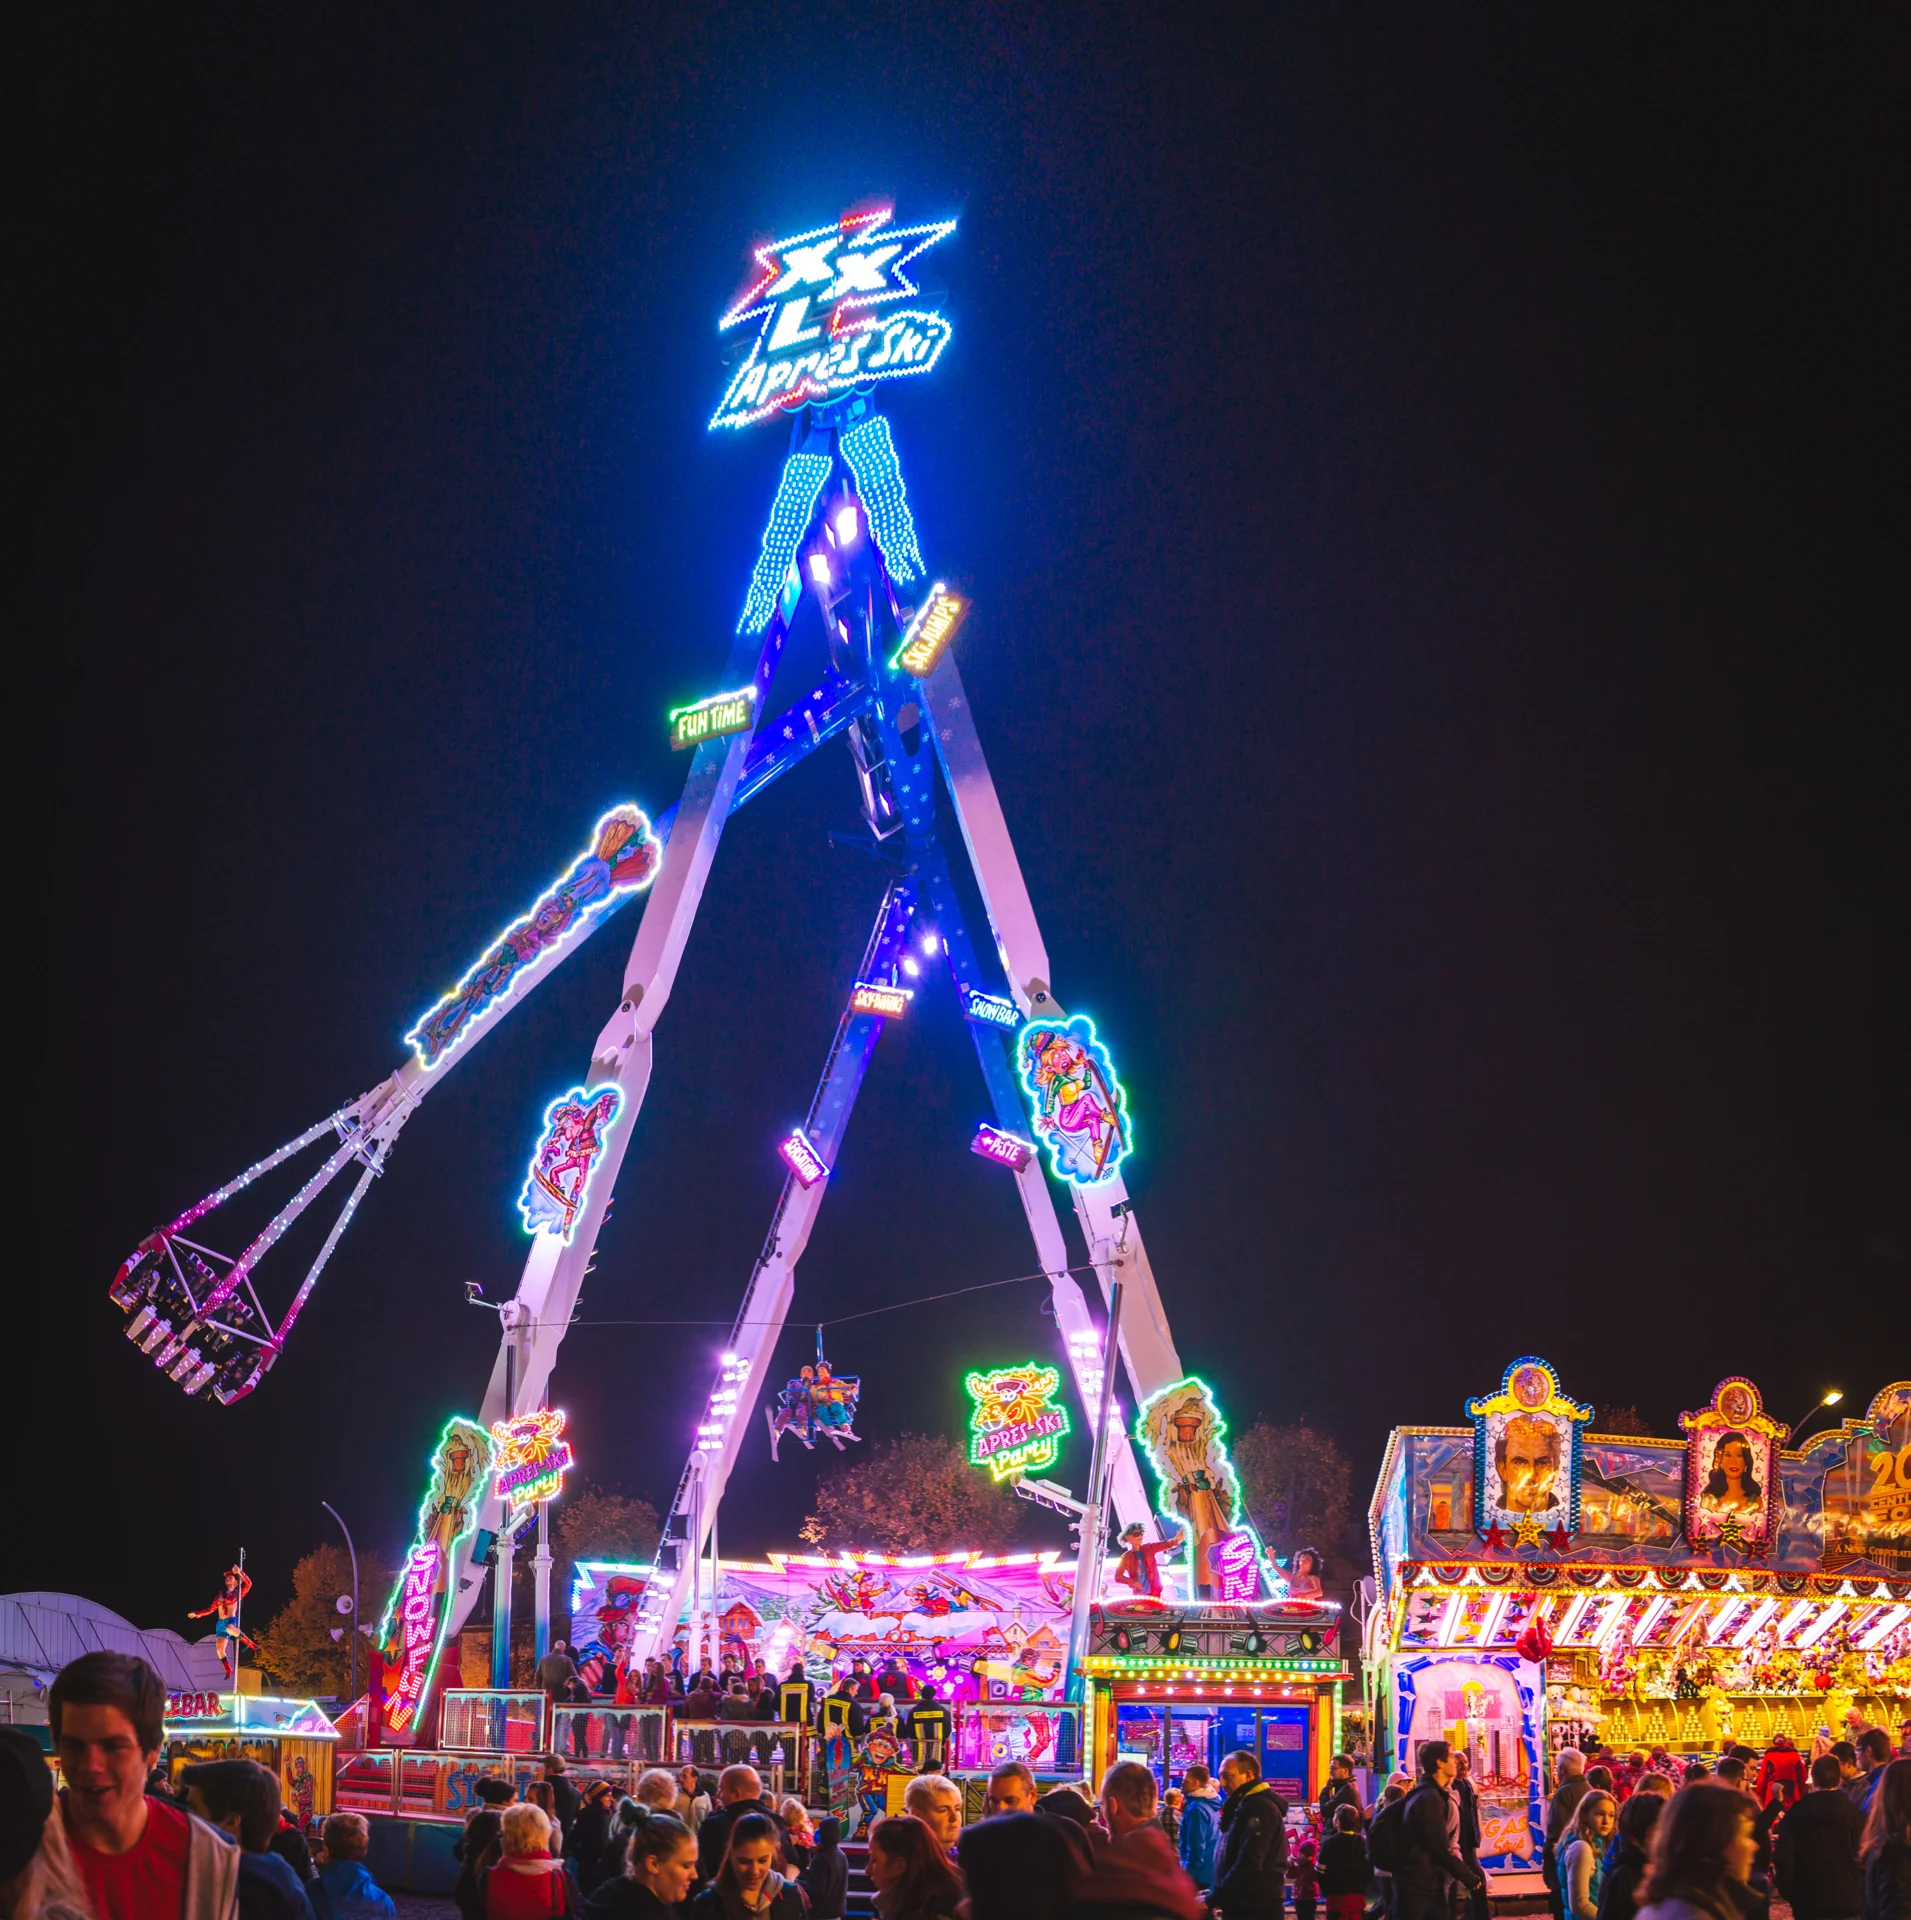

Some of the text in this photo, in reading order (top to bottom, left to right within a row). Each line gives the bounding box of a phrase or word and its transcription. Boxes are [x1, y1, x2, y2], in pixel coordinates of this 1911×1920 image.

[765, 237, 903, 303] XX
[767, 297, 821, 352] L
[678, 709, 709, 741] FUN
[996, 1437, 1053, 1471] Party
[513, 1471, 559, 1505] Party
[1242, 1728, 1255, 1738] 78
